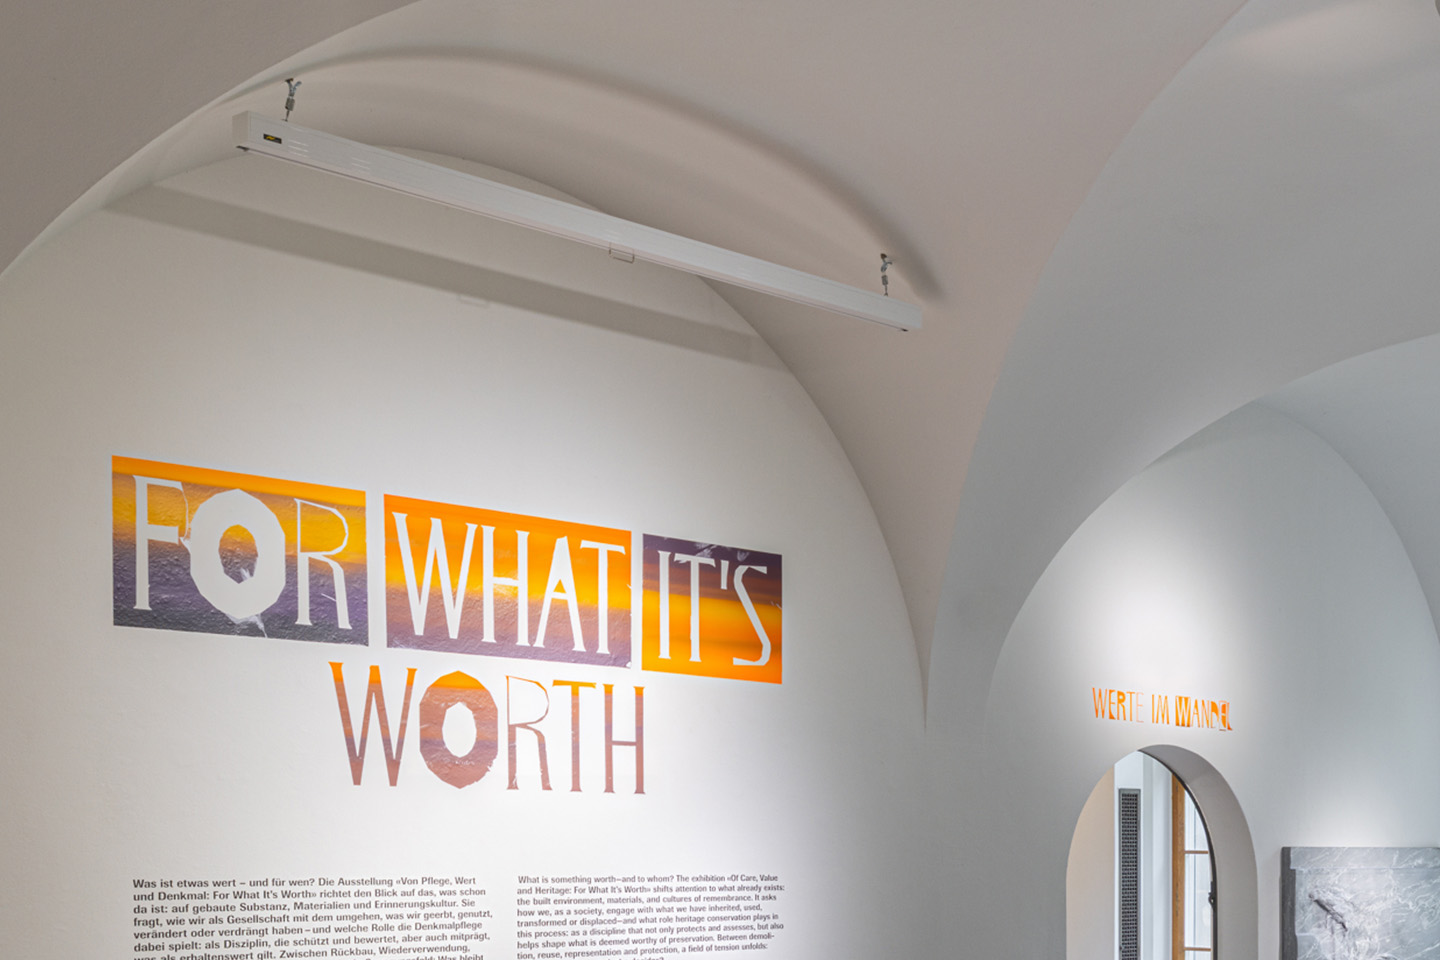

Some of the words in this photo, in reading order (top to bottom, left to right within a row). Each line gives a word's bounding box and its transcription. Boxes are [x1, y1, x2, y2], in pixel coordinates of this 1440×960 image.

[133, 474, 352, 630] FOR
[391, 512, 628, 656] WHAT
[657, 549, 772, 667] IT'S
[1092, 687, 1145, 723] WERTE
[1151, 693, 1170, 725] IM
[1175, 695, 1233, 732] WANDEL
[329, 660, 646, 796] WORTH
[133, 879, 157, 888] Was
[160, 879, 174, 888] ist
[177, 878, 210, 887] etwas
[212, 878, 237, 887] wert
[249, 878, 269, 887] und
[272, 878, 286, 887] für
[288, 878, 316, 887] wen?
[318, 878, 335, 886] Die
[337, 877, 394, 887] Ausstellung
[421, 877, 453, 887] Pflege,
[455, 877, 476, 885] Wert
[133, 891, 155, 901] und
[158, 891, 210, 900] Denkmal:
[213, 891, 231, 900] For
[232, 890, 260, 899] What
[263, 890, 279, 899] It's
[320, 889, 352, 898] richtet
[354, 889, 372, 898] den
[375, 889, 398, 897] Blick
[401, 889, 416, 897] auf
[418, 888, 437, 898] das,
[439, 889, 457, 897] was
[460, 888, 486, 896] schon
[517, 898, 531, 906] the
[533, 897, 552, 906] built
[646, 896, 661, 904] and
[662, 895, 693, 903] cultures
[694, 895, 702, 903] of
[754, 894, 760, 902] It
[761, 894, 777, 902] asks
[133, 904, 148, 913] da
[151, 904, 168, 913] ist:
[171, 903, 190, 913] auf
[192, 903, 237, 913] gebaute
[240, 902, 291, 913] Substanz,
[294, 901, 351, 910] Materialien
[353, 901, 372, 909] und
[375, 899, 459, 910] Erinnerungskultur.
[461, 899, 476, 907] Sie
[517, 909, 536, 917] how
[606, 908, 635, 916] engage
[637, 906, 654, 914] with
[656, 906, 675, 914] what
[689, 905, 707, 913] have
[133, 916, 163, 927] fragt,
[166, 916, 186, 925] wie
[188, 916, 206, 925] wir
[208, 915, 224, 924] als
[227, 914, 290, 924] Gesellschaft
[293, 914, 309, 922] mit
[312, 913, 334, 922] dem
[336, 912, 383, 923] umgehen,
[406, 911, 422, 920] wir
[423, 911, 456, 921] geerbt,
[458, 910, 493, 920] genutzt,
[134, 942, 165, 952] dabei
[168, 941, 202, 952] spielt:
[205, 940, 221, 949] als
[224, 939, 272, 950] Disziplin,
[274, 938, 290, 947] die
[293, 937, 330, 947] schützt
[332, 936, 351, 945] und
[354, 935, 399, 946] bewertet,
[402, 934, 423, 943] aber
[425, 933, 448, 942] auch
[450, 932, 491, 943] mitprägt,
